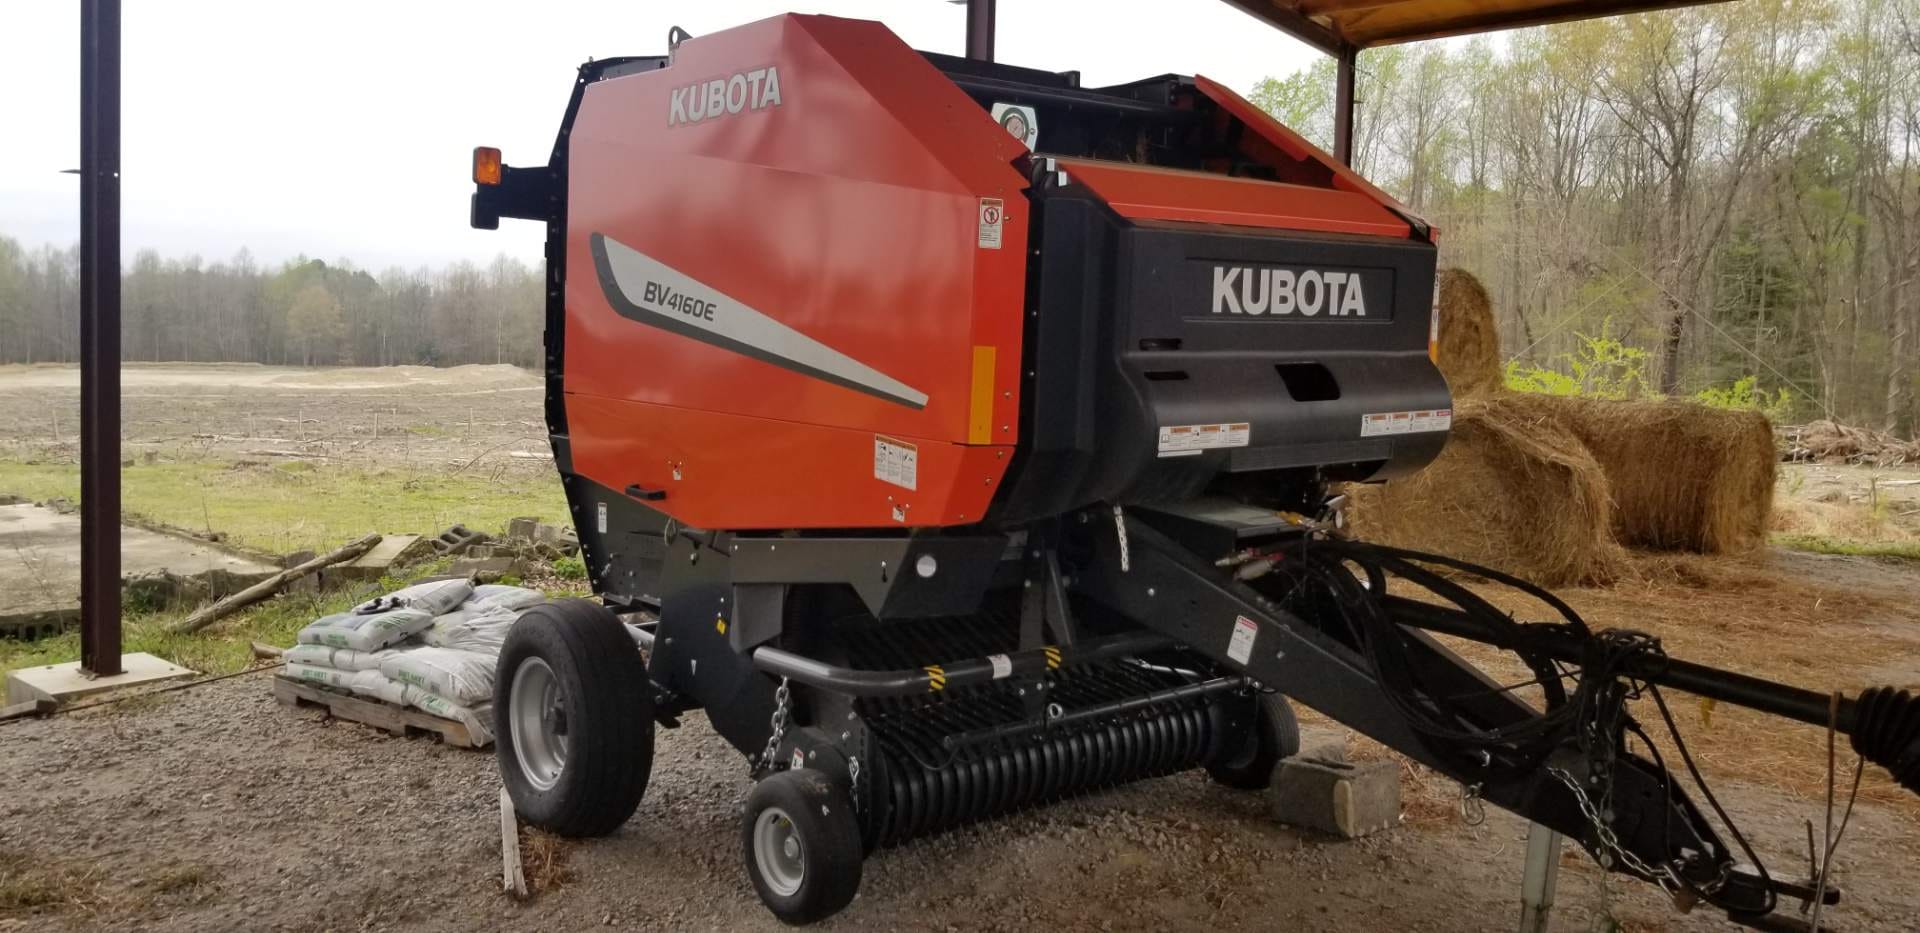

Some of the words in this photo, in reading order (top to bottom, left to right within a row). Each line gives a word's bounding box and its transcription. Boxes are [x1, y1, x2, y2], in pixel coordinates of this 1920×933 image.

[668, 66, 782, 127] KUBOTA
[643, 280, 717, 322] BV4160E
[1212, 266, 1366, 317] KUBOTA
